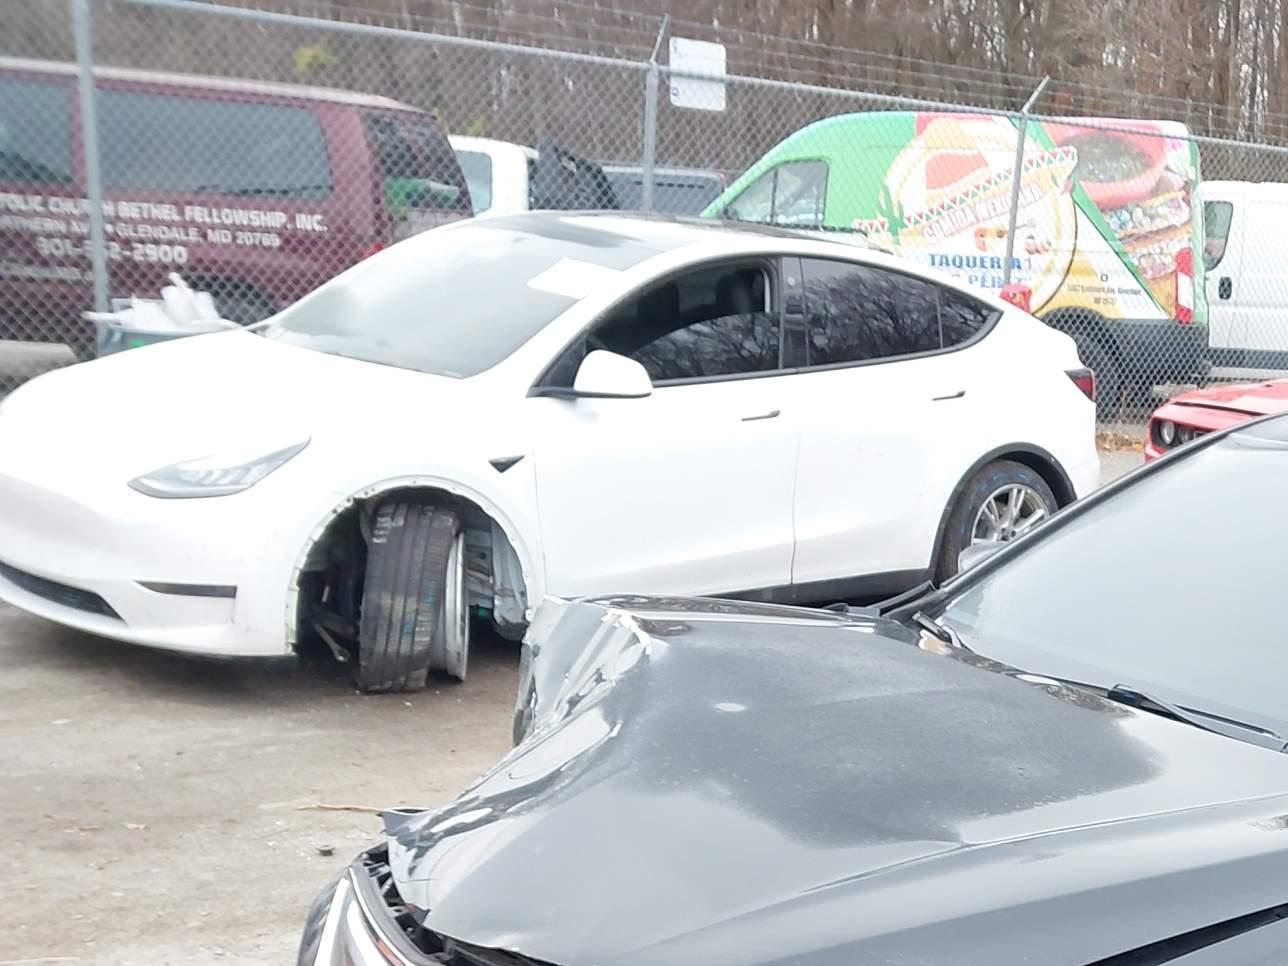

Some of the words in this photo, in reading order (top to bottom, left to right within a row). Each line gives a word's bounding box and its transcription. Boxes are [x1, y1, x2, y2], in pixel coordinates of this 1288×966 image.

[117, 201, 180, 221] BETHEL
[295, 213, 328, 231] INC.
[207, 229, 233, 243] MD
[36, 236, 188, 264] 301-32-2900
[929, 253, 1022, 270] TAQUERA
